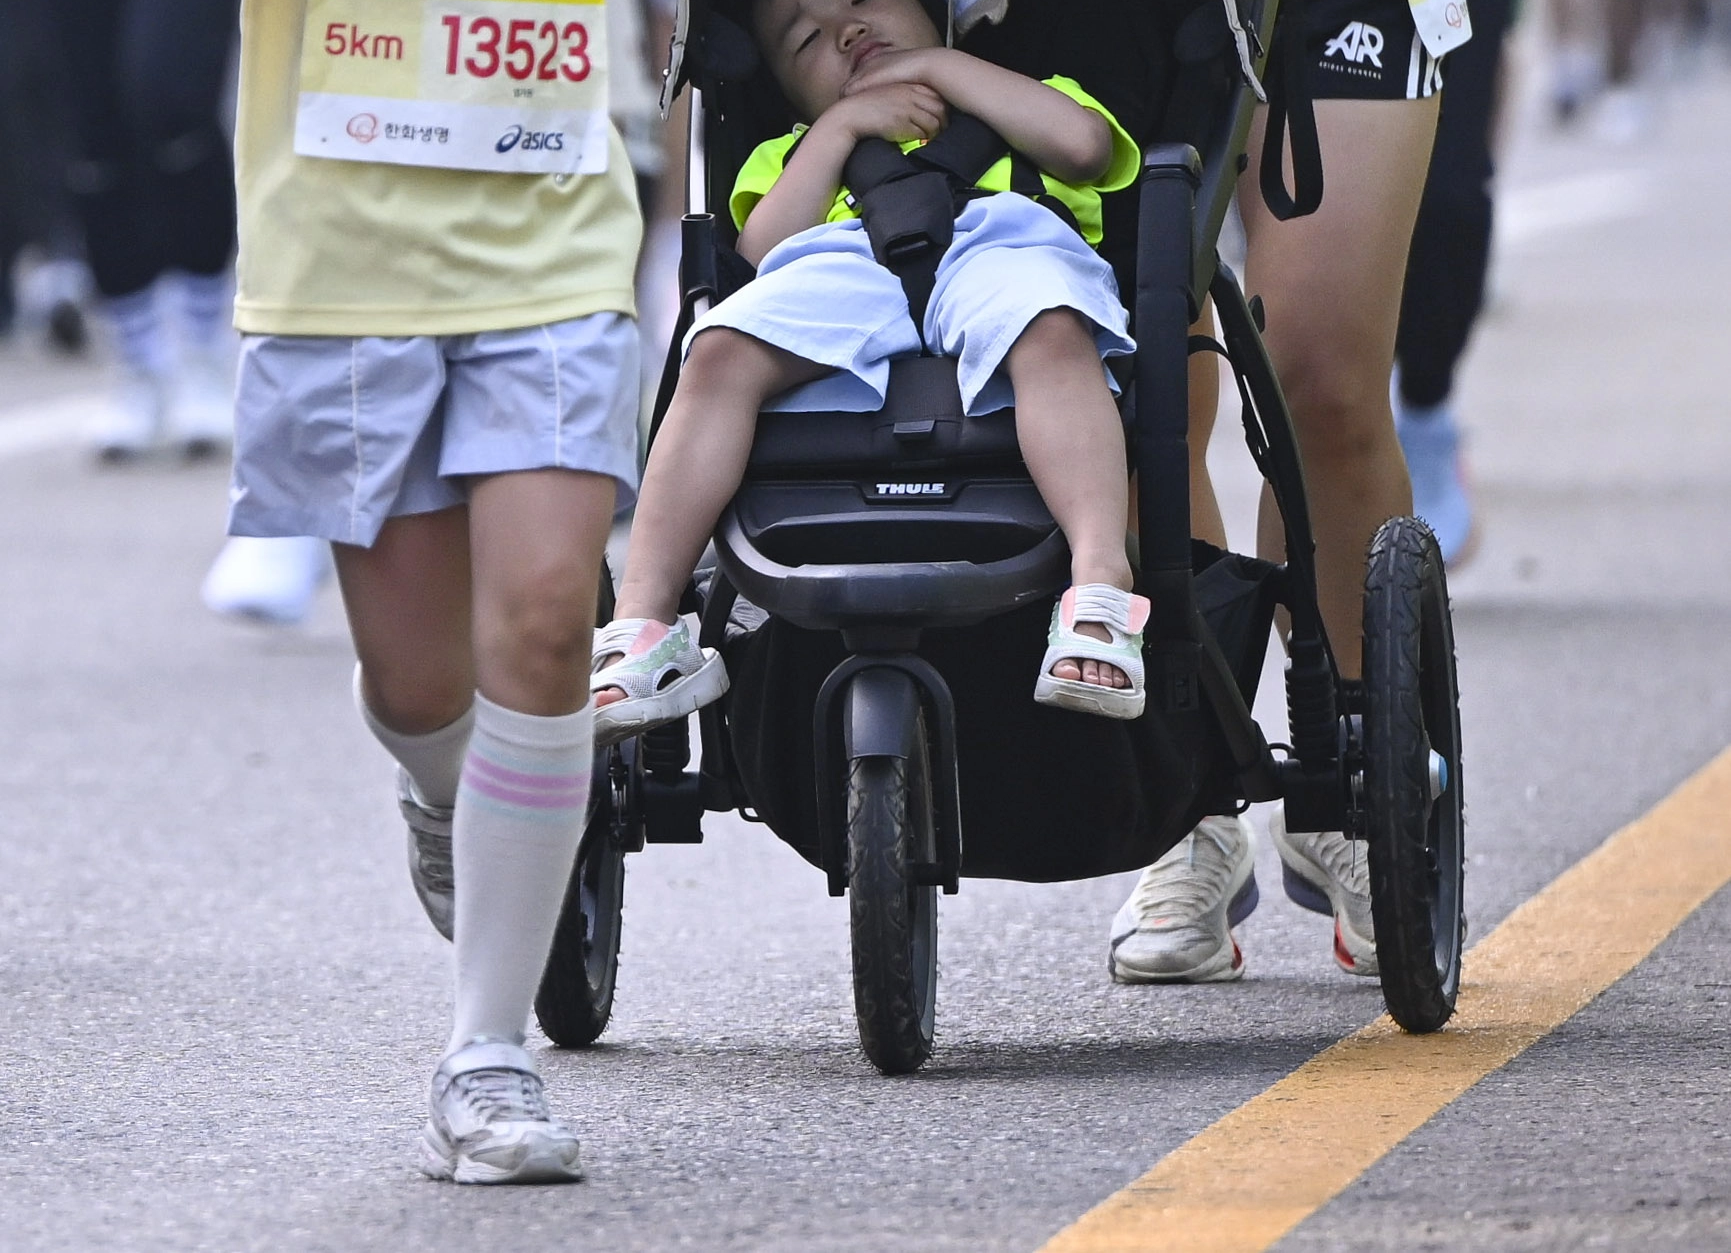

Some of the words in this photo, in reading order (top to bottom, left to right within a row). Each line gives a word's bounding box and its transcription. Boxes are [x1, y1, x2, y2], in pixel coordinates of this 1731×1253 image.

[325, 23, 404, 61] 5km
[441, 15, 592, 82] 13523
[384, 123, 450, 143] 한화생명
[875, 483, 945, 495] THULE
